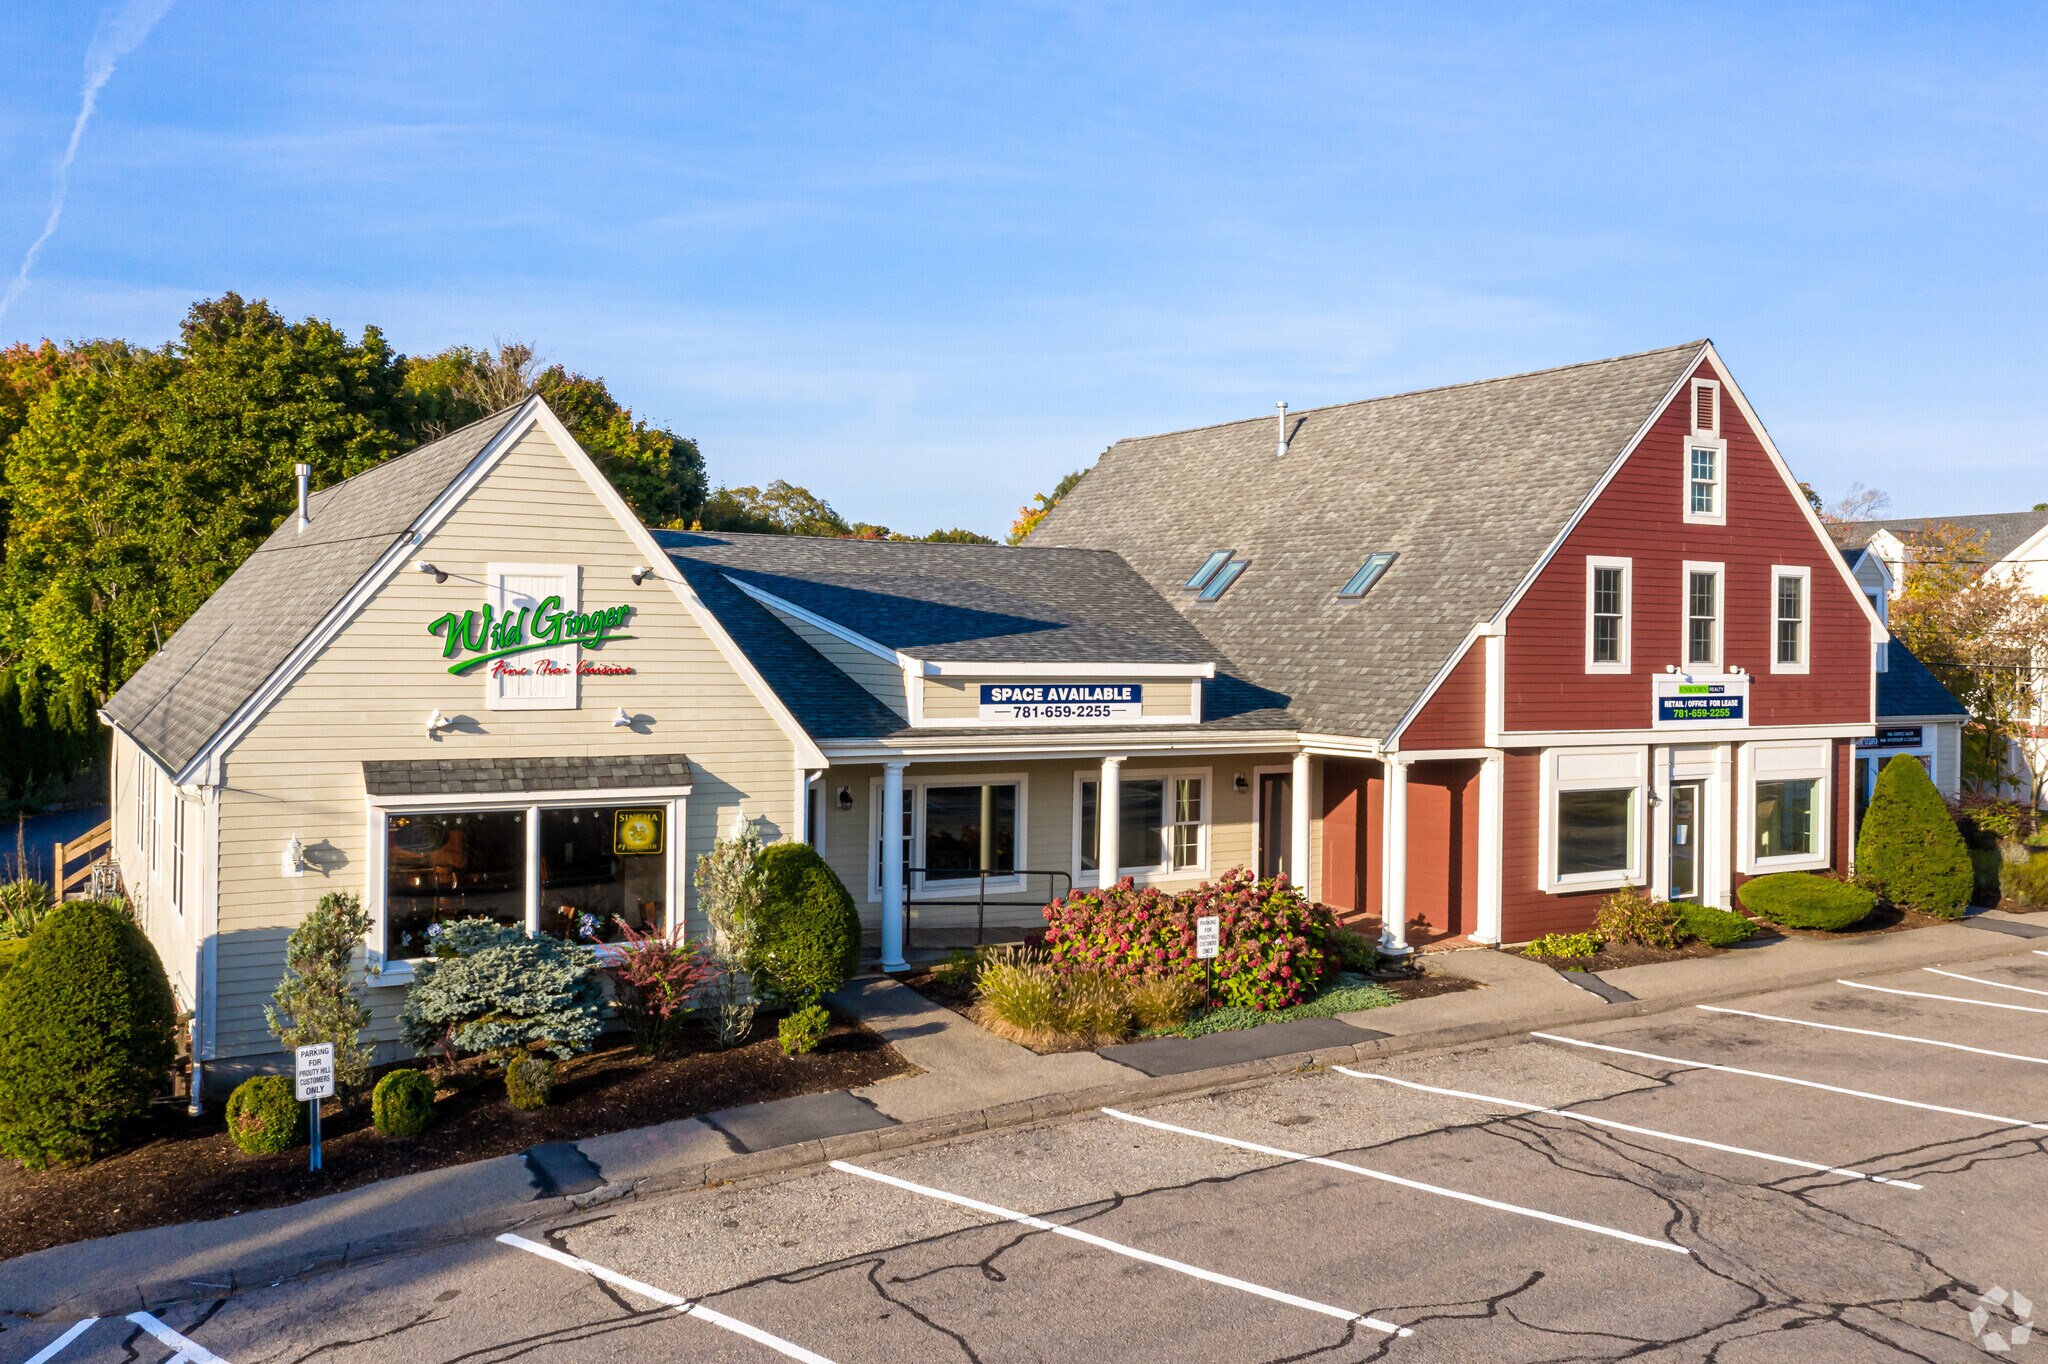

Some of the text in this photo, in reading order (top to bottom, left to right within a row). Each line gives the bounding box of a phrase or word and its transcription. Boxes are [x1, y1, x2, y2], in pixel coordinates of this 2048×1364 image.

[428, 595, 629, 657] Wild Ginger
[491, 659, 633, 679] Fine Thai Cuisine
[991, 687, 1132, 701] SPACE AVAILABLE
[1680, 685, 1708, 693] UNICORN
[1664, 700, 1685, 708] RETAIL
[1688, 699, 1707, 707] OFFICE
[1721, 699, 1739, 707] LEASE
[1013, 705, 1111, 718] 781-659-2255
[1673, 708, 1730, 718] 781-659-2255
[619, 814, 658, 822] SINGHA
[301, 1047, 330, 1058] PARKING
[309, 1059, 321, 1067] FOR
[299, 1066, 331, 1078] PROUTY HILL
[300, 1075, 330, 1086] CUSTOMERS
[306, 1085, 325, 1095] ONLY
